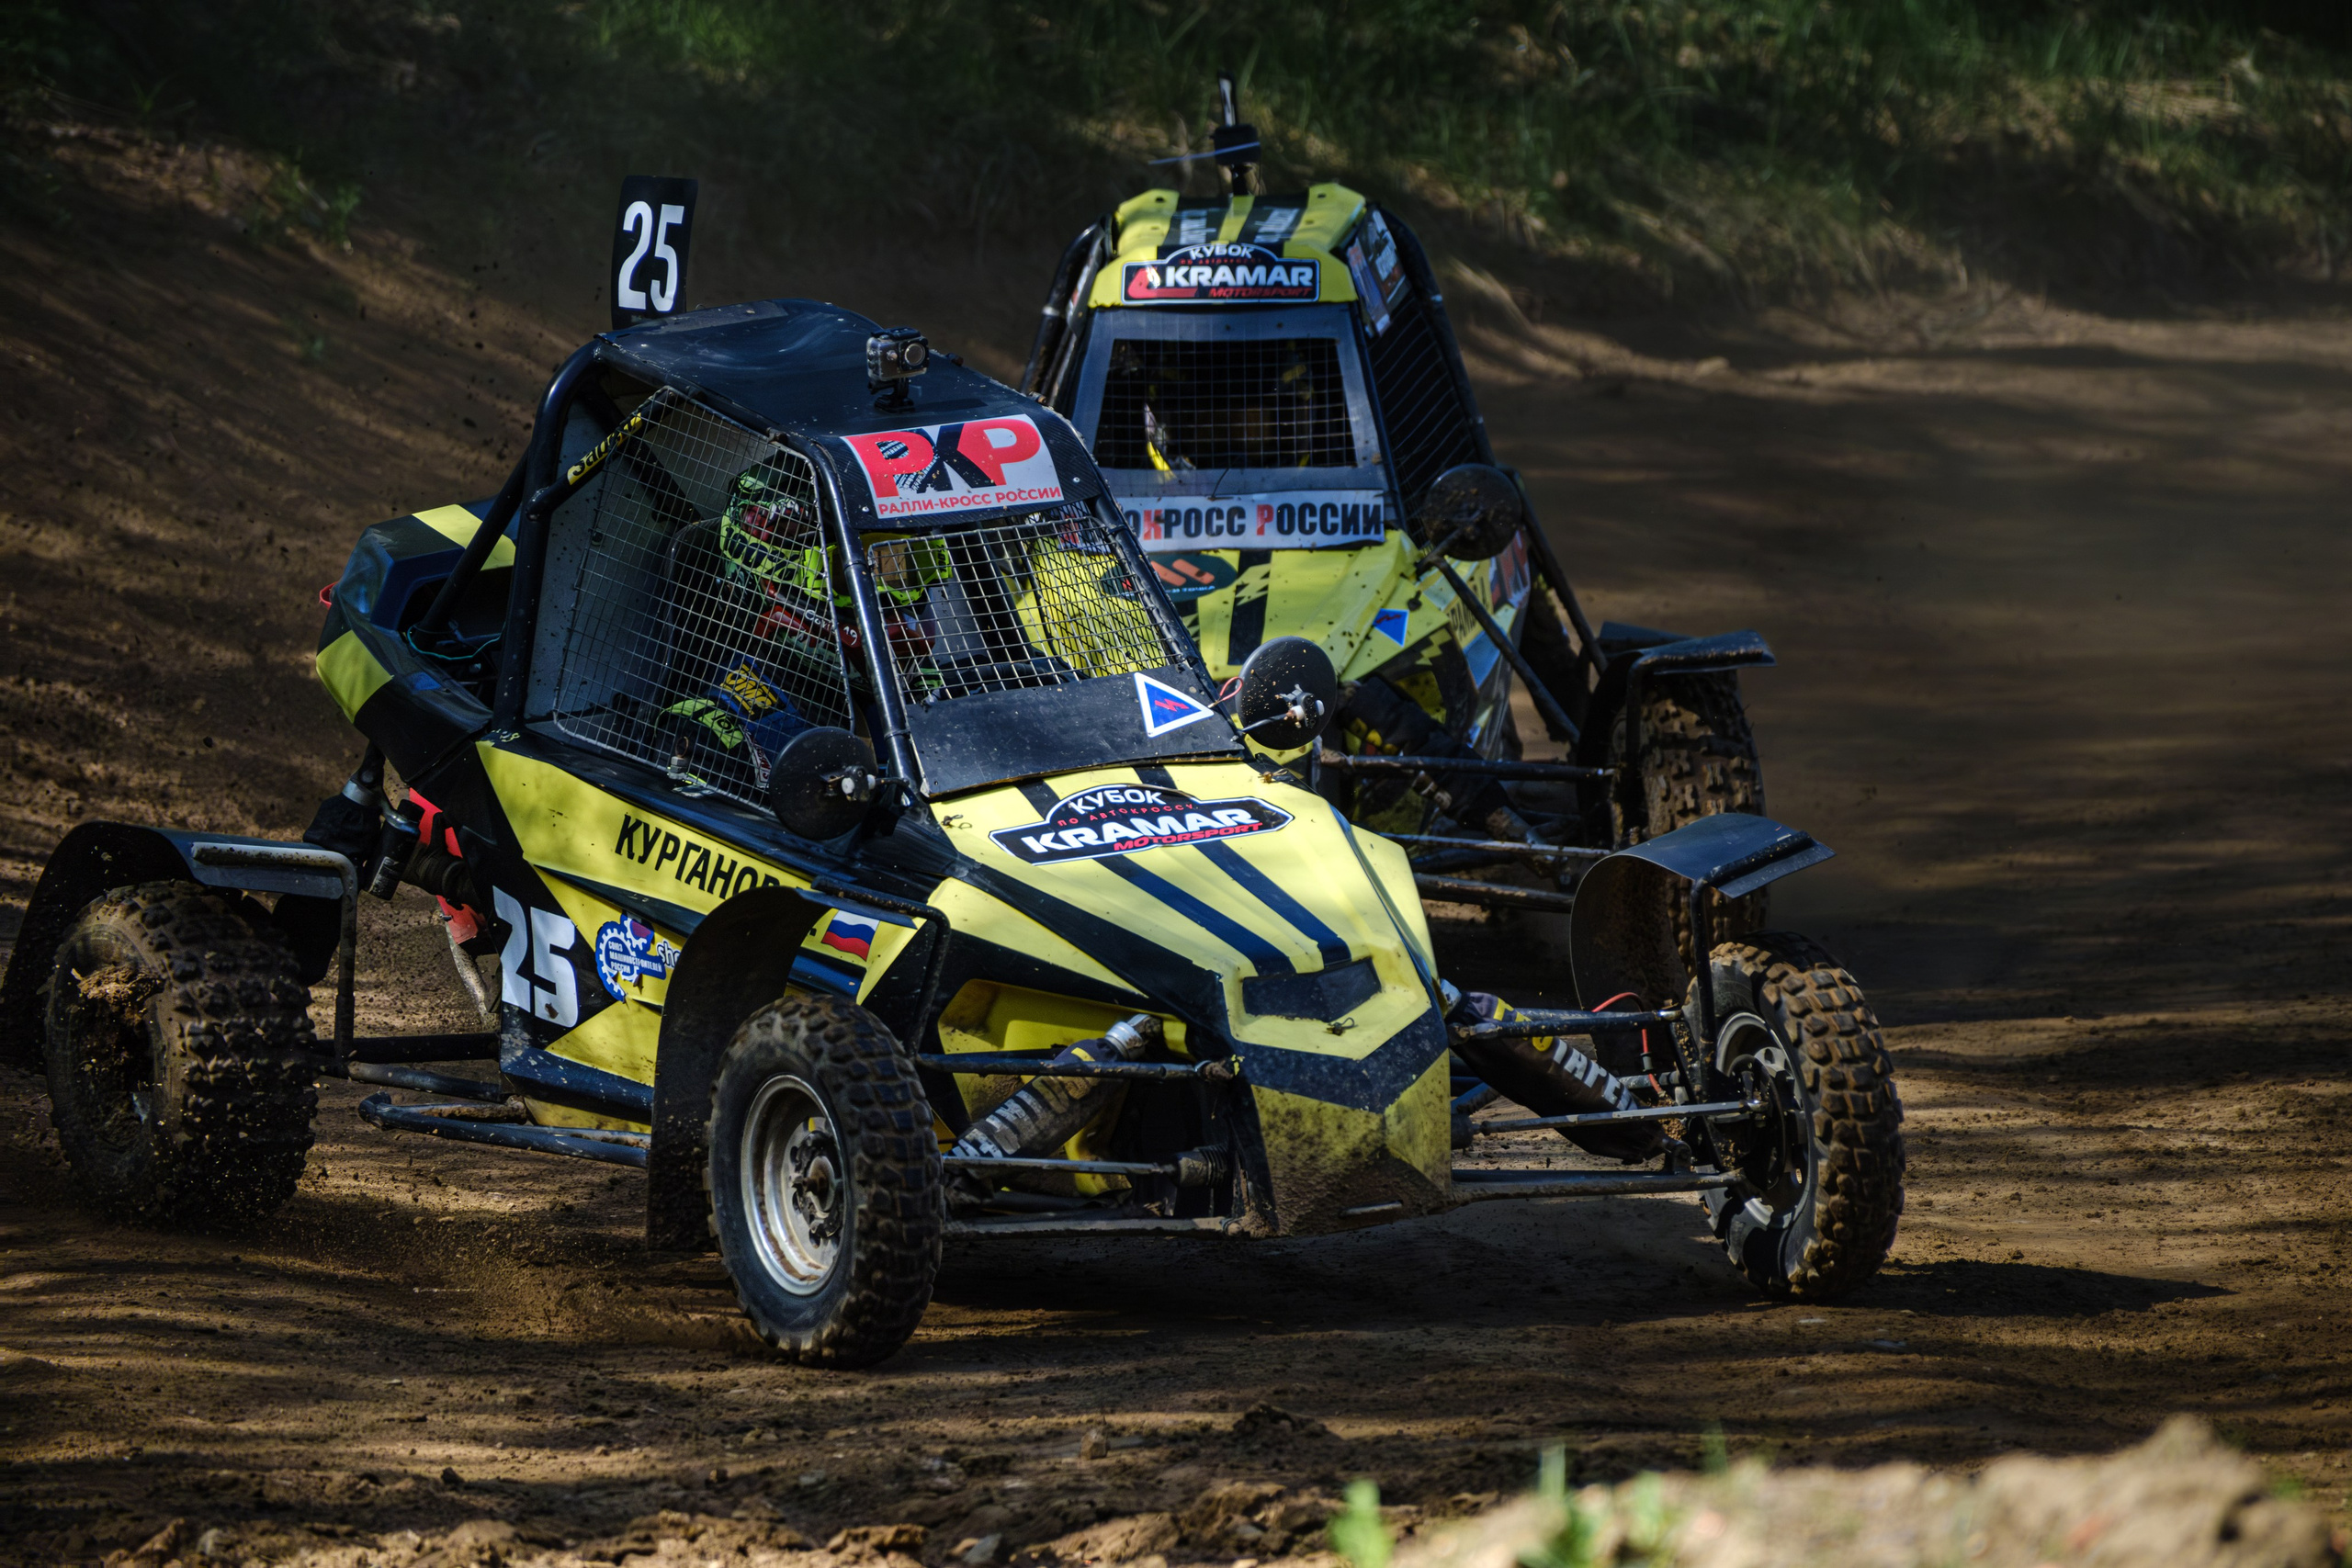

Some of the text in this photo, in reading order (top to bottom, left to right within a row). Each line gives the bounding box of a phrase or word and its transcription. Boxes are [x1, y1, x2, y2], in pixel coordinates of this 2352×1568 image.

[618, 201, 684, 312] 25
[1189, 243, 1255, 260] КУБОК
[1166, 265, 1313, 288] KRAMAR
[1209, 287, 1312, 298] MOTORSPORT
[878, 486, 1062, 515] РАЛЛИ-КРОСС РОССИИ
[1256, 502, 1382, 536] РОССИИ
[1057, 803, 1193, 827] ПО АВТОКРОССУ
[1069, 789, 1167, 815] КУБОК
[1022, 808, 1260, 853] KRAMAR
[1113, 822, 1263, 852] MOTORSPORT
[492, 885, 579, 1028] 25
[610, 961, 631, 974] РОССИИ
